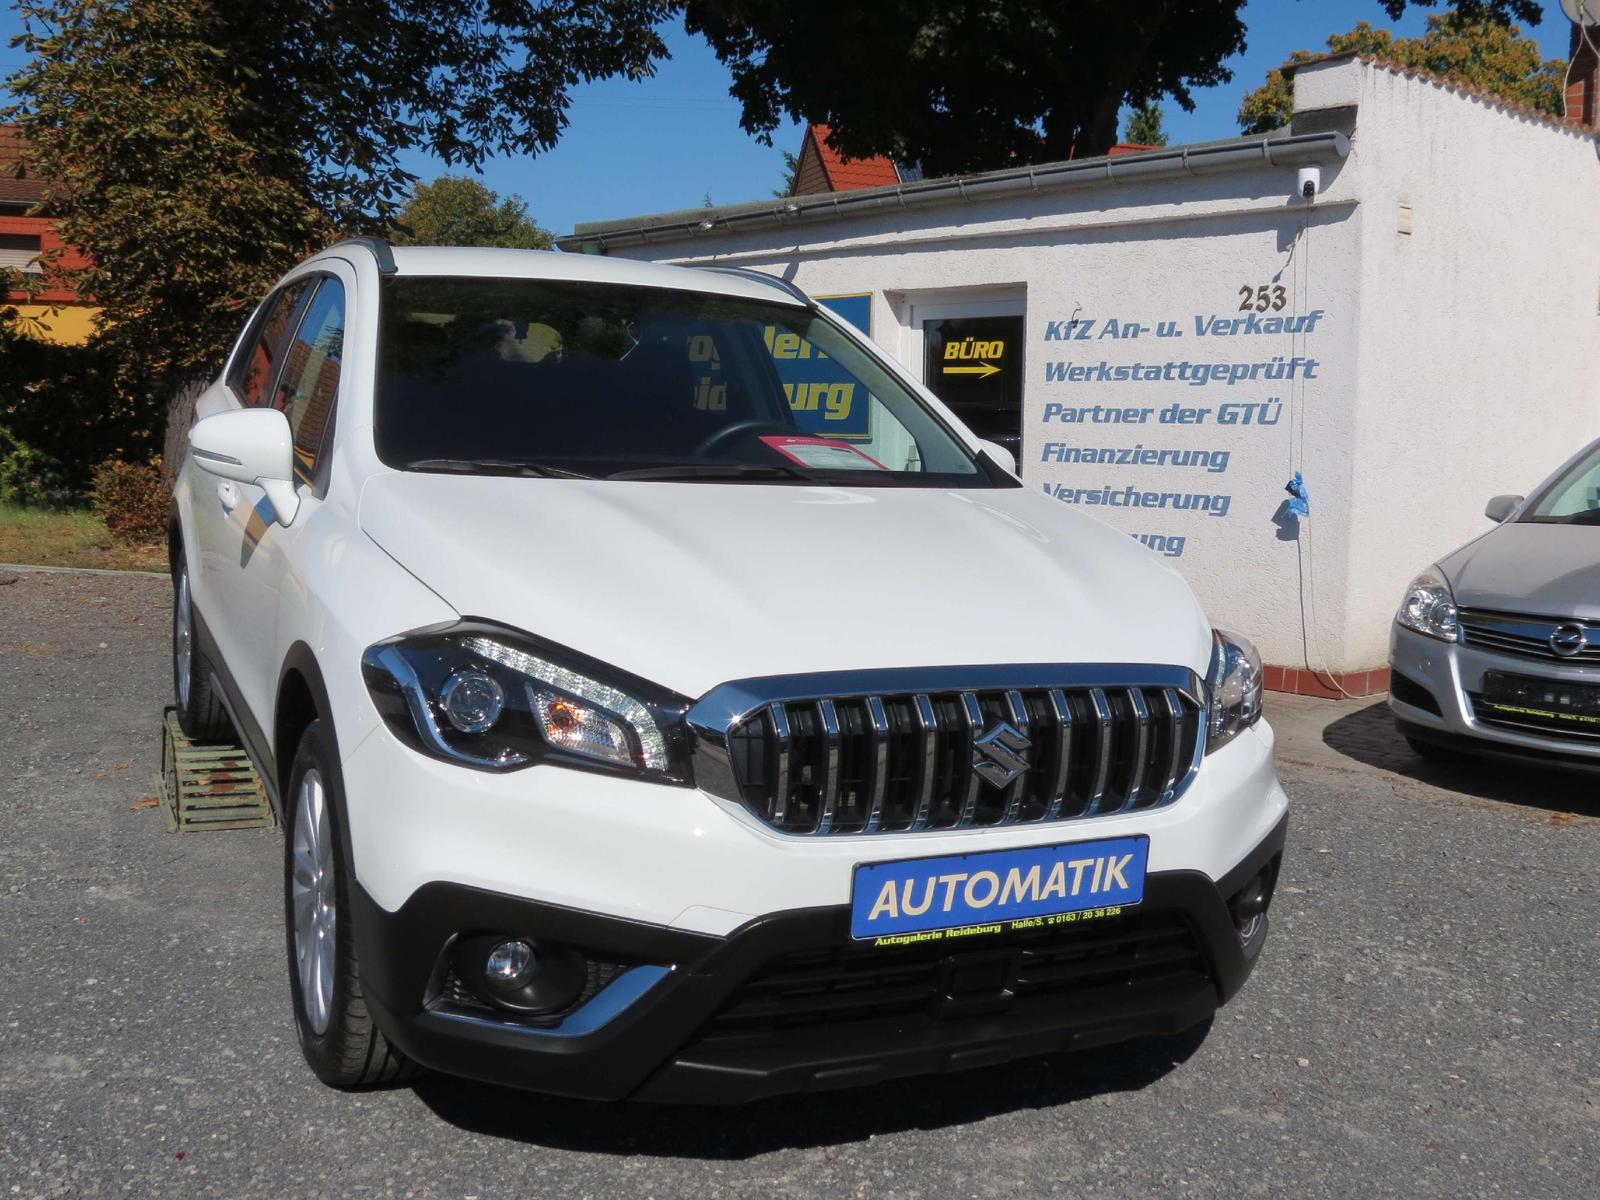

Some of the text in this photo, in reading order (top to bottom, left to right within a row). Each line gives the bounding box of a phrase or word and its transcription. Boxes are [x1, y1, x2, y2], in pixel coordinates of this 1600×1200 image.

[1239, 284, 1287, 312] 253
[1044, 310, 1324, 341] KfZ An- u. Verkauf
[943, 337, 1005, 360] BÜRO
[1045, 357, 1320, 386] Werkstattgeprüft
[1043, 397, 1283, 425] Partner der GTÜ
[1041, 443, 1231, 473] Finanzierung
[868, 854, 1134, 920] AUTOMATIK
[874, 931, 943, 947] Autogalerie
[945, 924, 1002, 939] Reideburg
[1056, 914, 1076, 924] 0163
[1083, 911, 1093, 920] 20
[1106, 907, 1121, 916] 226
